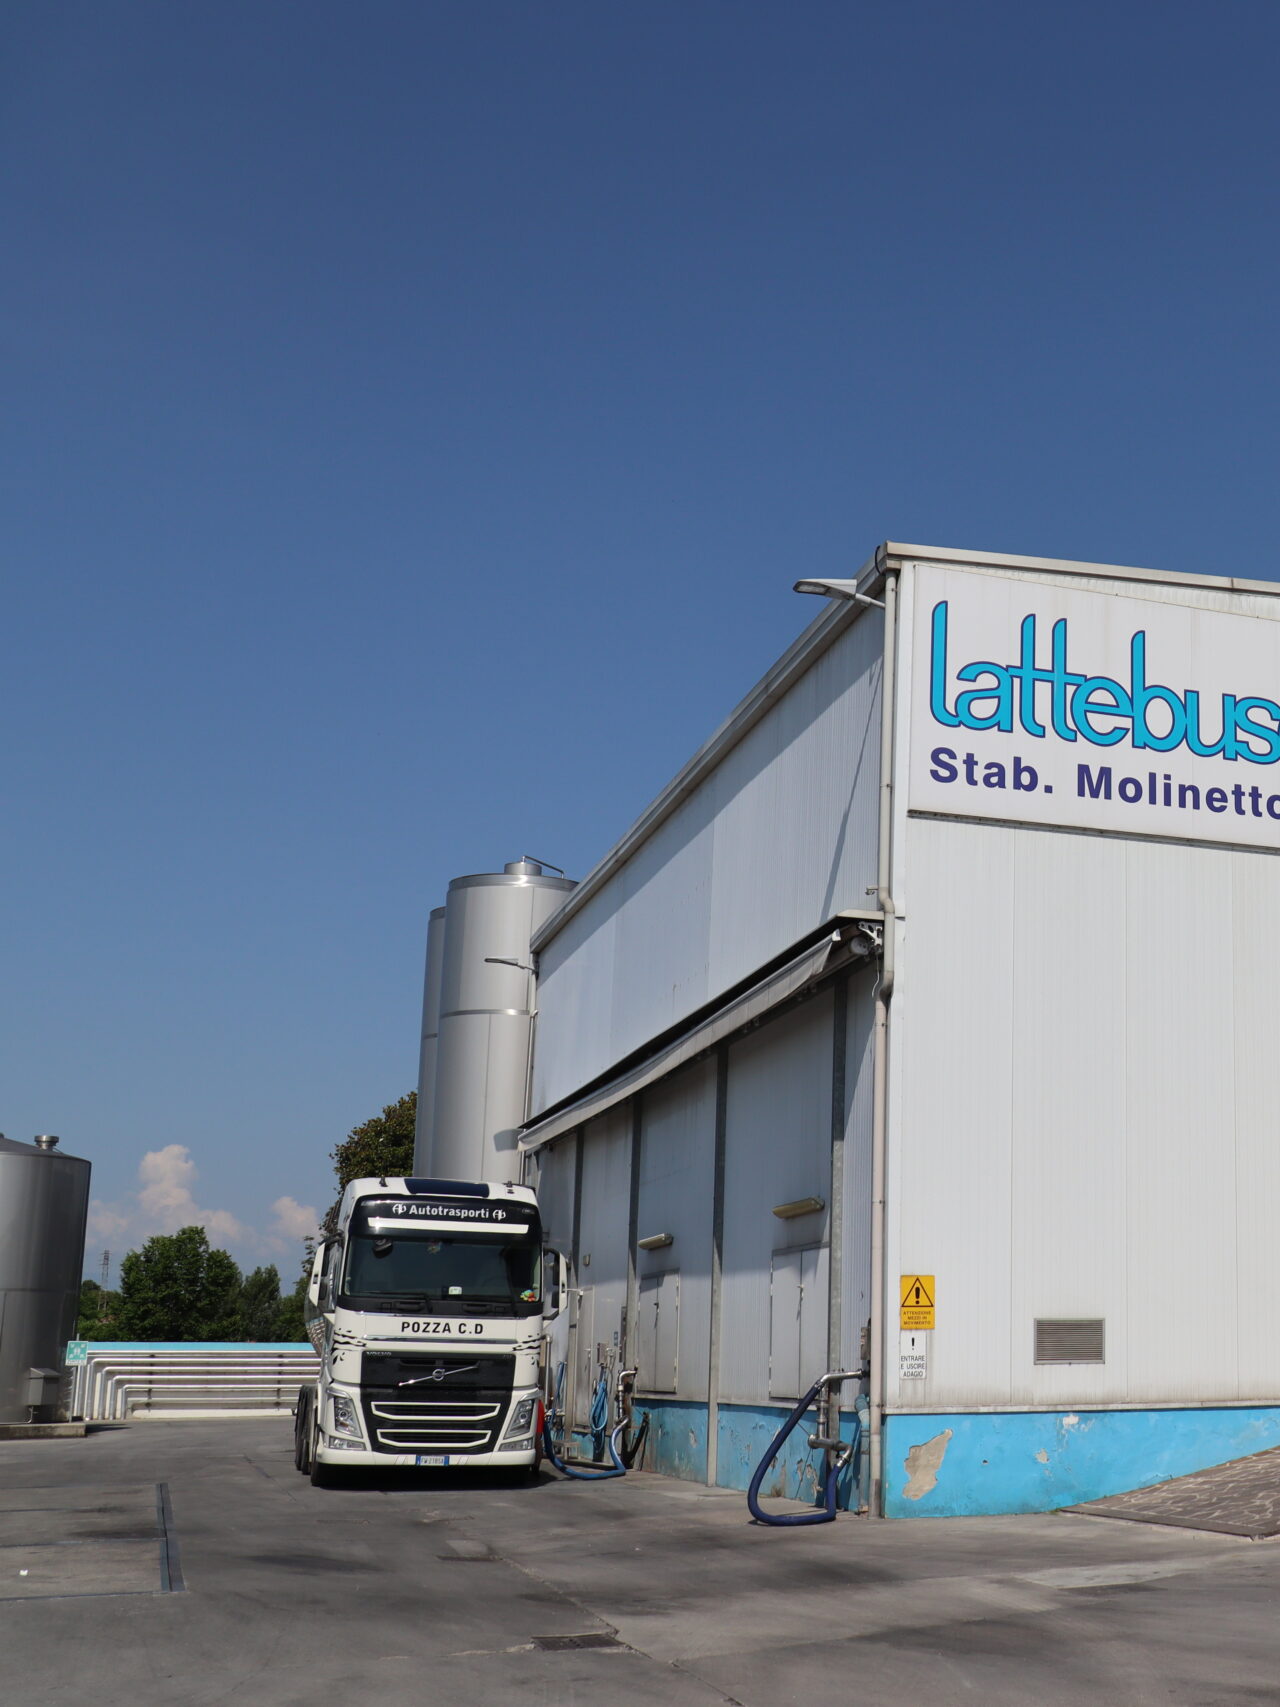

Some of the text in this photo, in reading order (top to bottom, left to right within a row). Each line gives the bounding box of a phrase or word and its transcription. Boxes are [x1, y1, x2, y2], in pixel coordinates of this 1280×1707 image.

[929, 746, 1054, 795] Stab.
[409, 1204, 489, 1218] Autotrasporti
[401, 1321, 484, 1335] POZZA C.D
[906, 1362, 926, 1370] USCIRE
